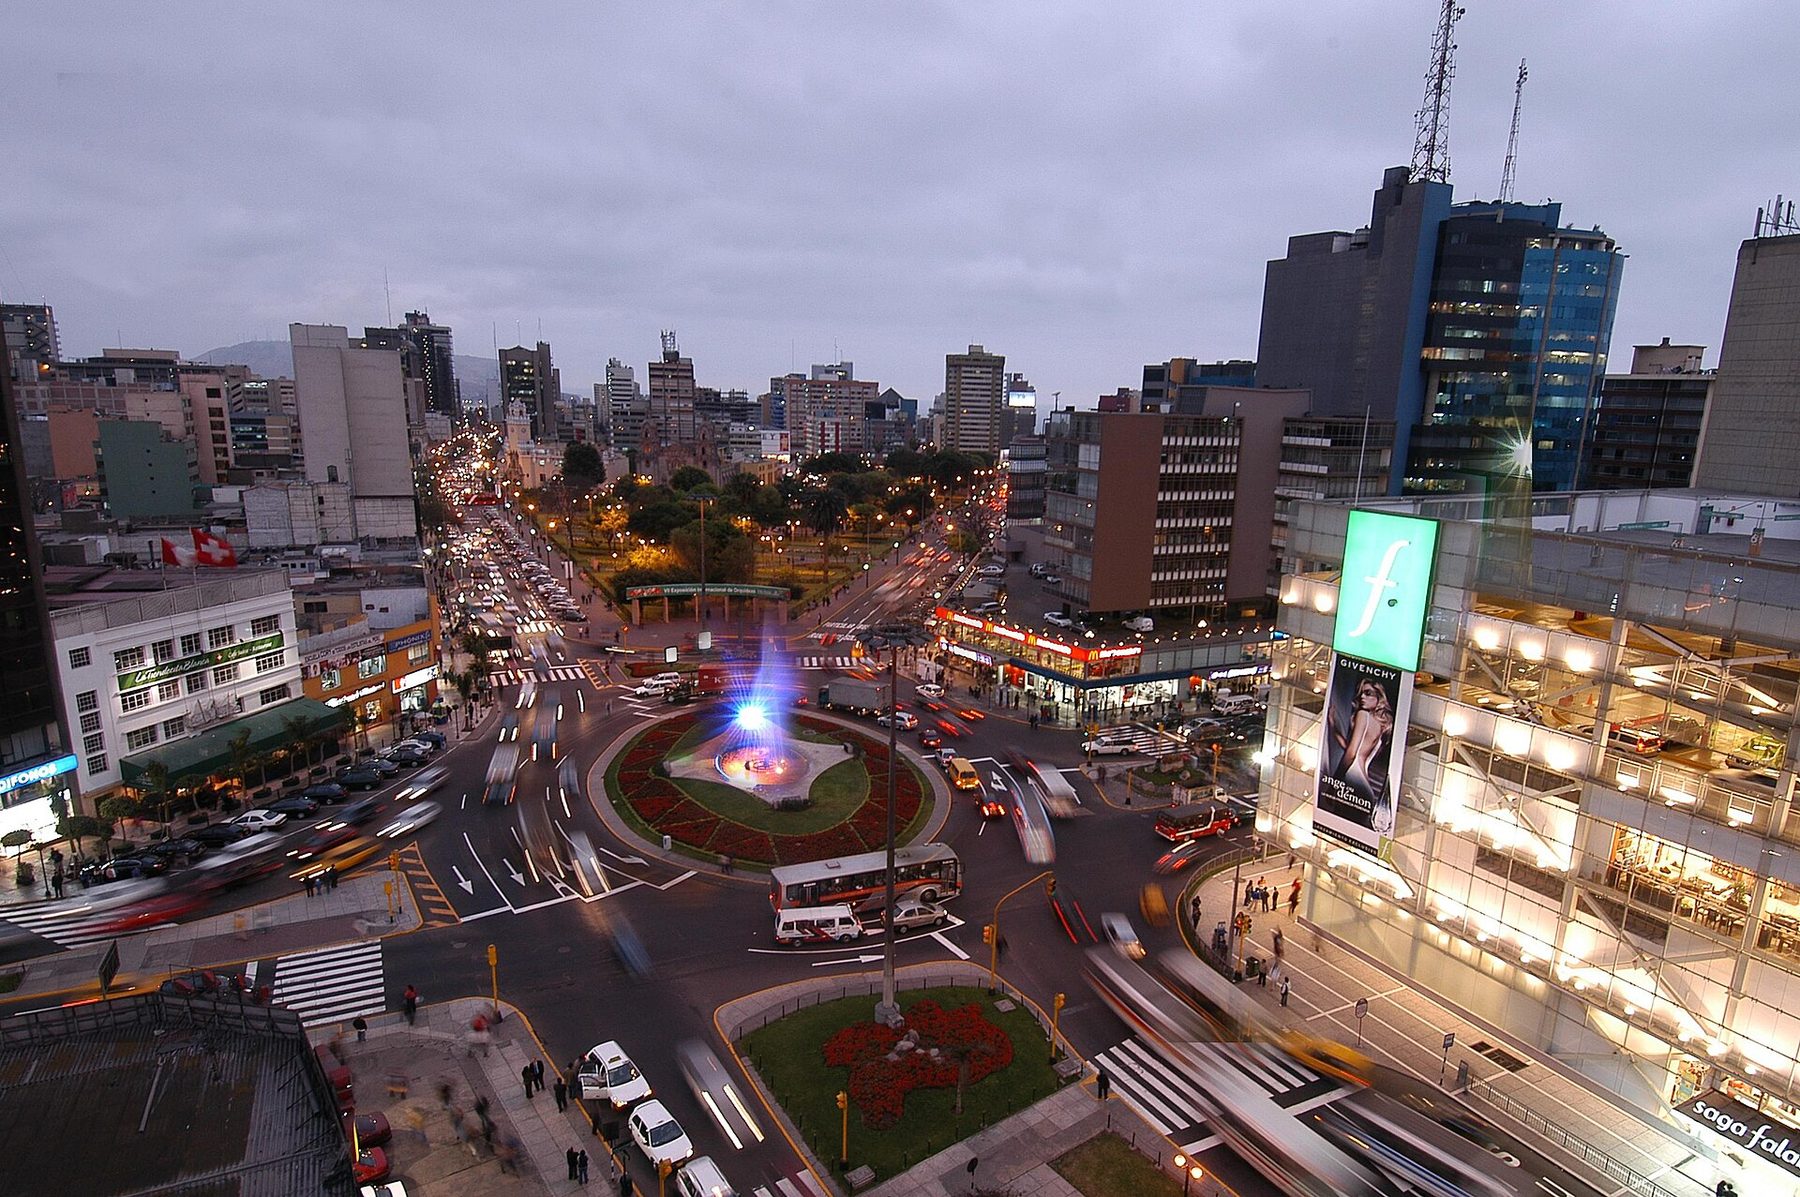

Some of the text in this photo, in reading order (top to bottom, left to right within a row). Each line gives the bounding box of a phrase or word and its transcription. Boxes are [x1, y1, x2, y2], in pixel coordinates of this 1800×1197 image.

[1340, 659, 1396, 680] GIVENCHY
[1321, 774, 1346, 789] ange
[1336, 786, 1372, 809] démon
[1692, 1100, 1800, 1169] saga fala
